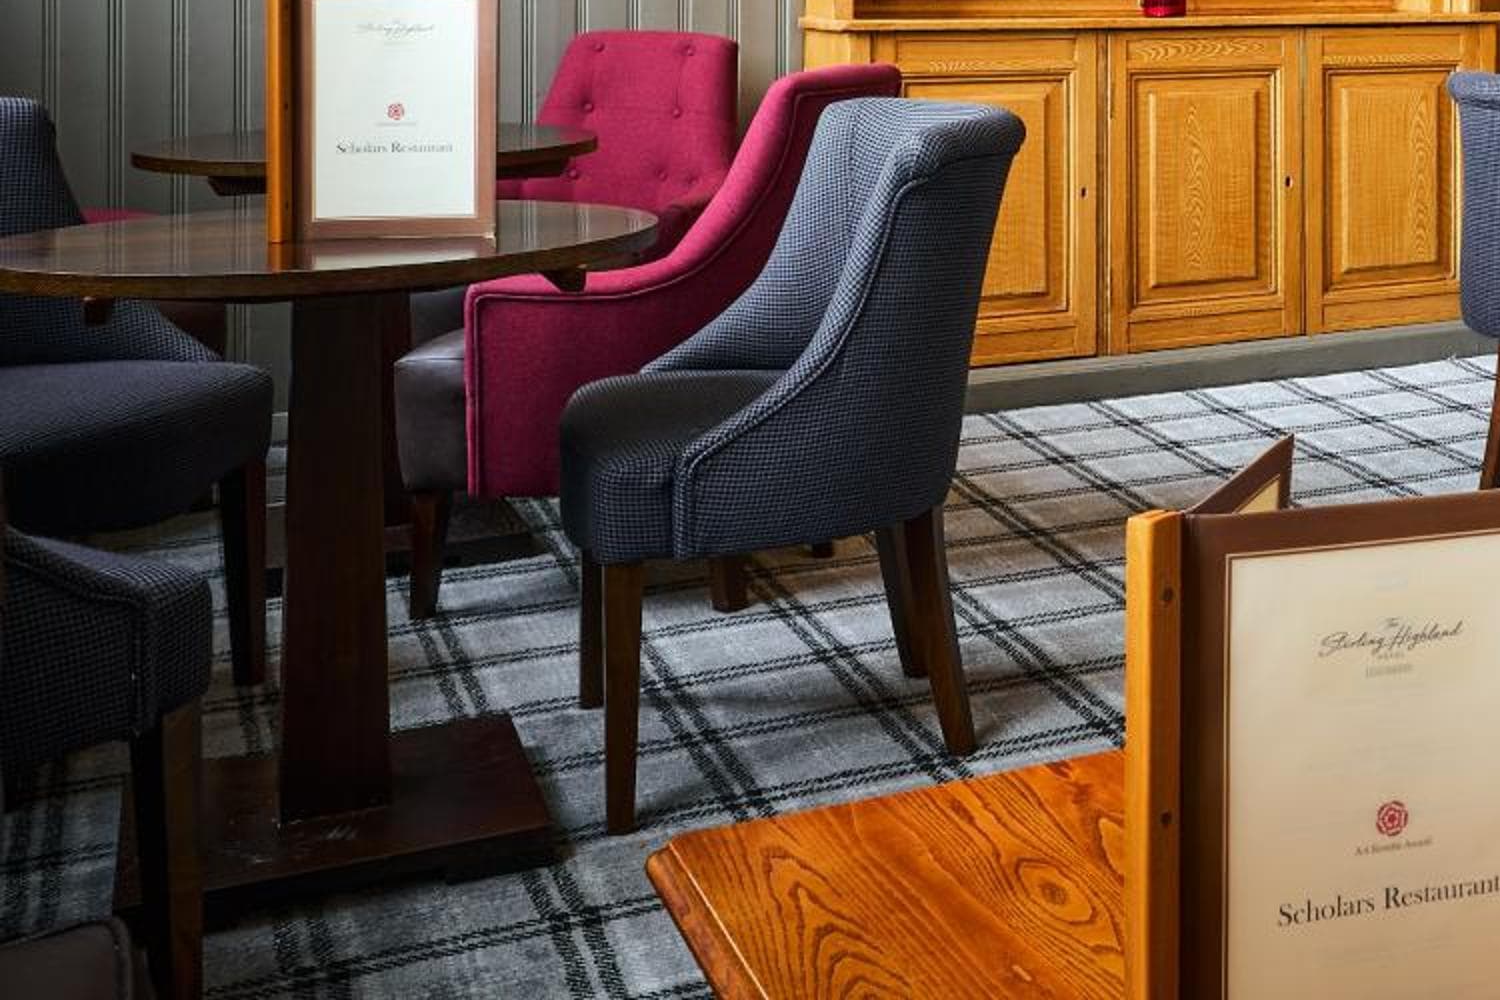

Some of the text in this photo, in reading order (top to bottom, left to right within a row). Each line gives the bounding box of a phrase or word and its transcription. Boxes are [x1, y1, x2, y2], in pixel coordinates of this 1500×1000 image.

[1317, 620, 1463, 657] Stirling Highland
[1277, 875, 1500, 928] Scholars Restaurant
